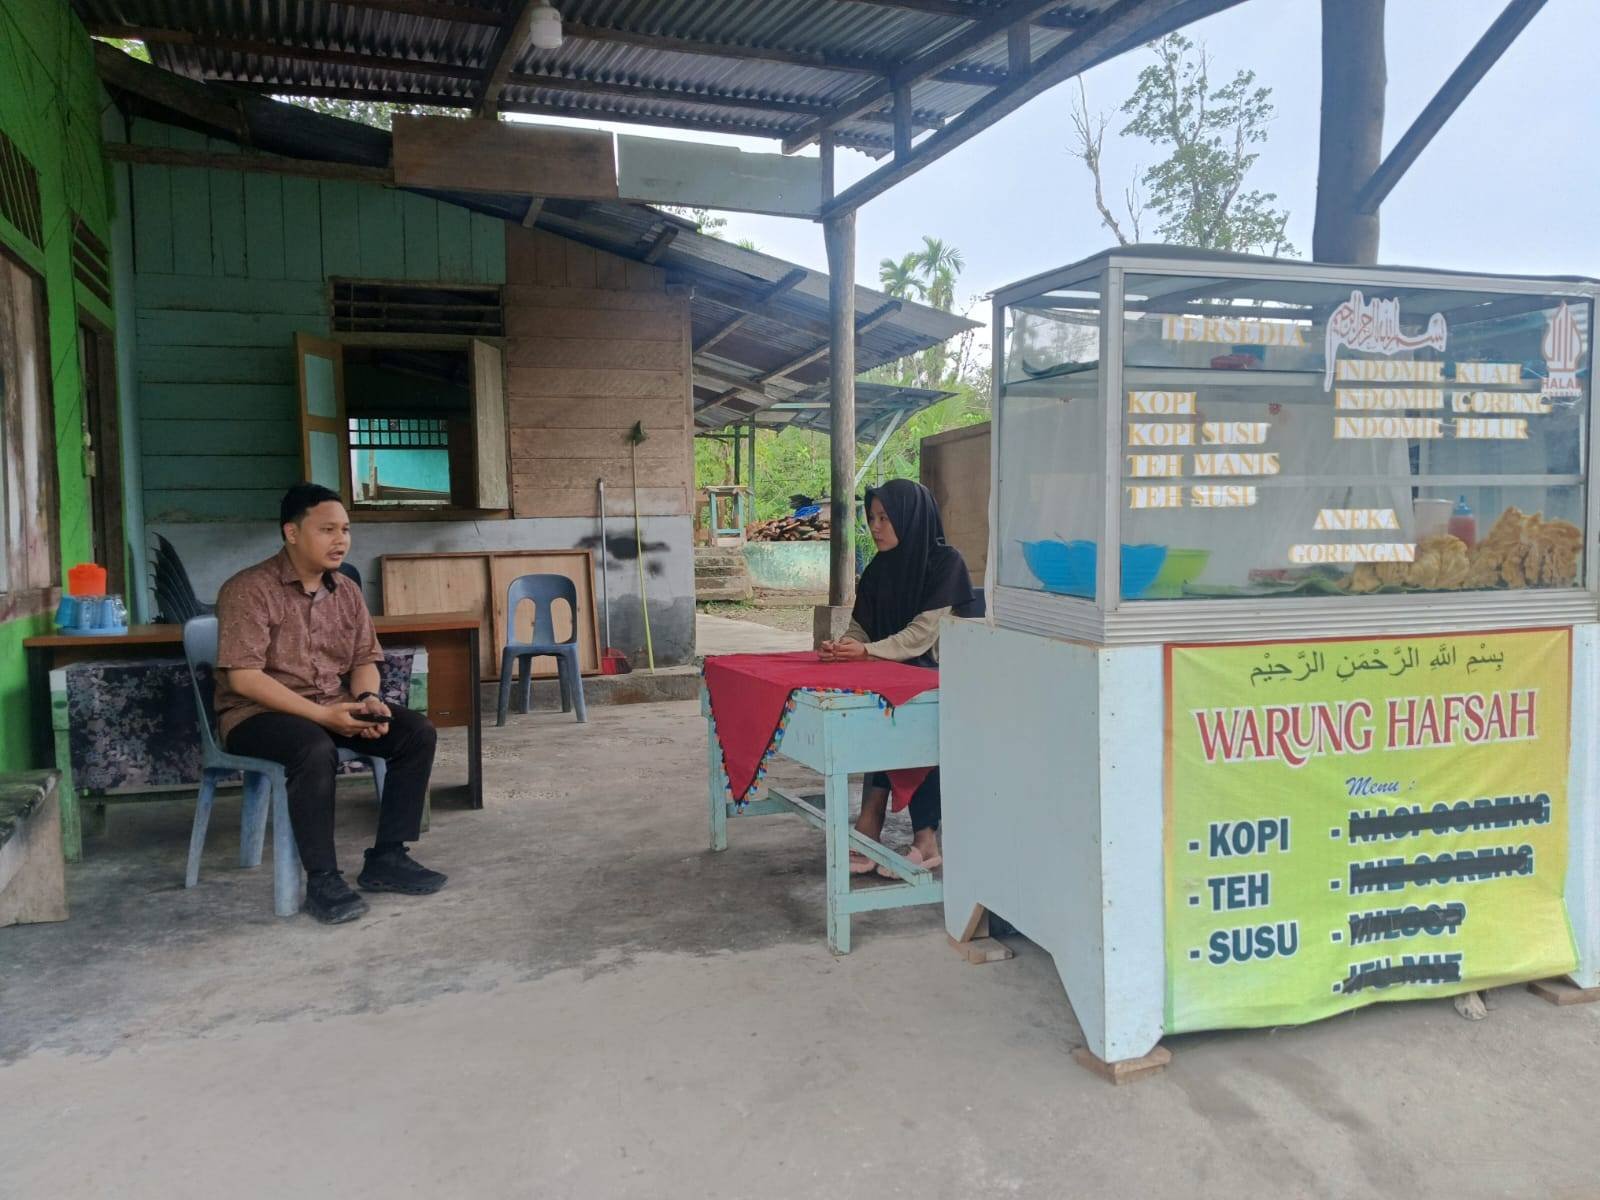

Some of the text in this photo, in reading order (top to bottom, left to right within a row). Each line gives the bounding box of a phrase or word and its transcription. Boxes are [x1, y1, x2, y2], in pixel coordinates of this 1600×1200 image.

[1162, 316, 1307, 347] TERSEDIA
[1335, 360, 1522, 384] INDOMIE KUAH
[1128, 391, 1196, 414] KOPI
[1335, 388, 1552, 413] INDOMIE GORENG
[1128, 422, 1271, 445] KOPI SUSU
[1334, 416, 1528, 439] INDOMIE TELUR
[1127, 453, 1280, 477] TEH MANIS
[1127, 486, 1257, 508] TEH SUSU
[1312, 508, 1400, 530] ANEKA
[1288, 543, 1417, 562] GORENGAN
[1195, 690, 1537, 766] WARUNG HAFSAH
[1345, 776, 1400, 796] Menu
[1209, 817, 1290, 857] KOPI
[1207, 873, 1270, 911] TEH
[1208, 921, 1298, 965] SUSU
